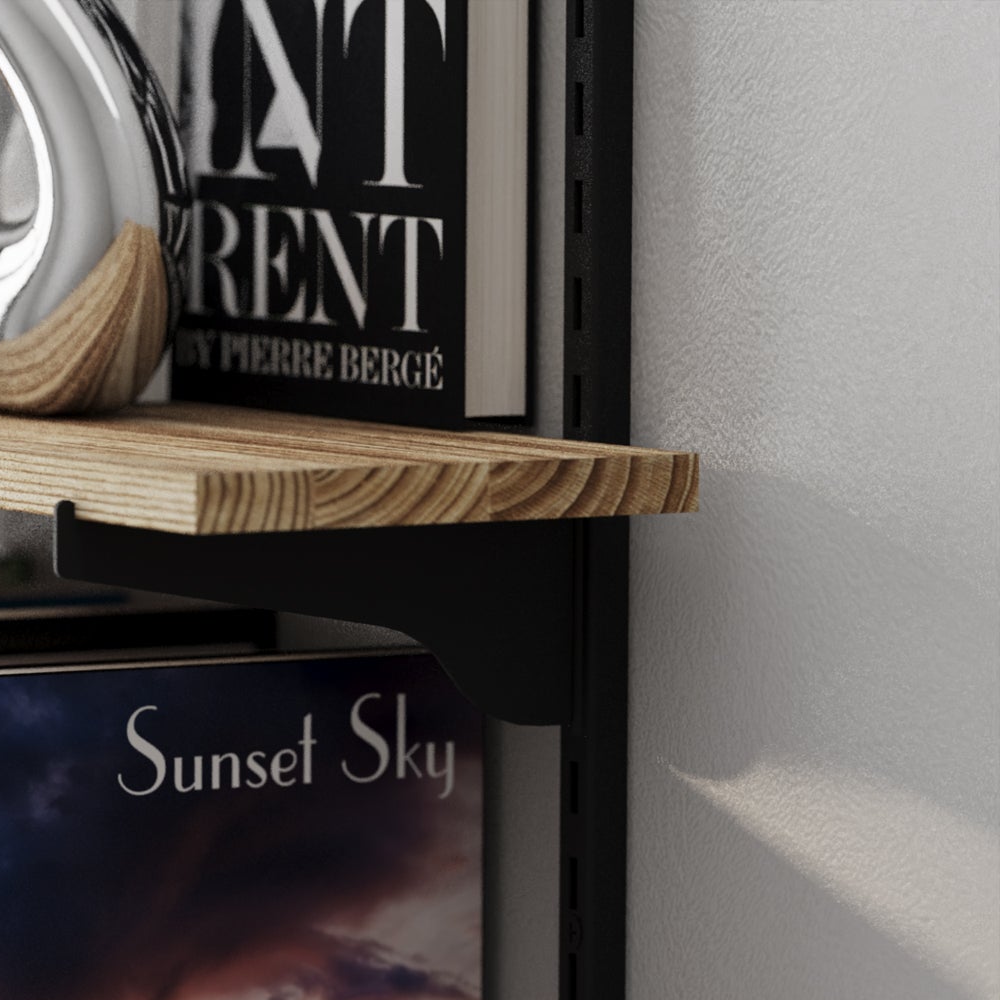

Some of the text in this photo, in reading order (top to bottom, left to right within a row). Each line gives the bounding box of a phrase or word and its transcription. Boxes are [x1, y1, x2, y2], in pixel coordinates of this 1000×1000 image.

[219, 329, 333, 380] PIERRE
[339, 346, 444, 391] BERGÉ
[118, 692, 456, 799] Sunset Sky
